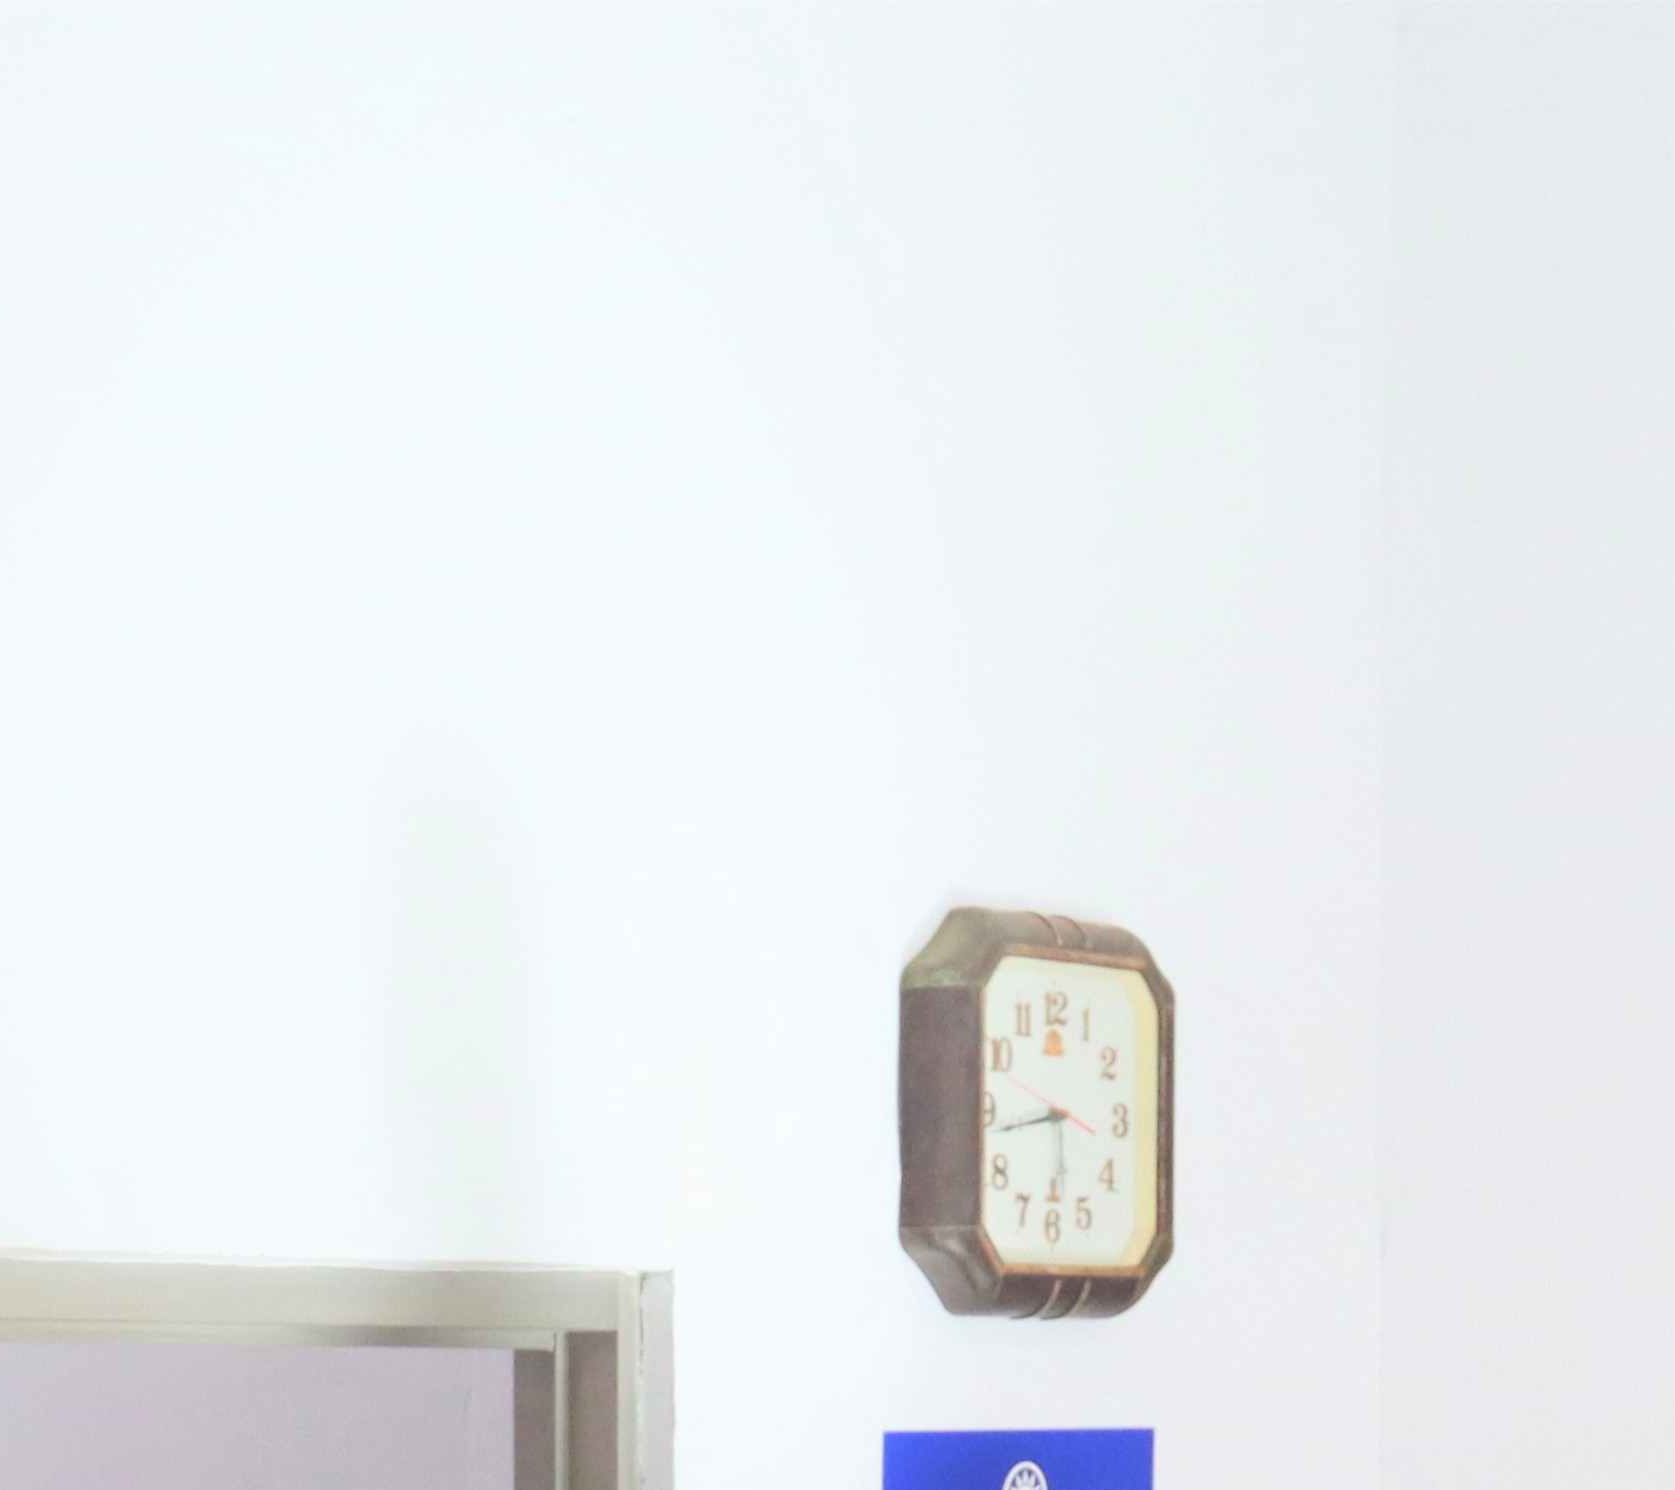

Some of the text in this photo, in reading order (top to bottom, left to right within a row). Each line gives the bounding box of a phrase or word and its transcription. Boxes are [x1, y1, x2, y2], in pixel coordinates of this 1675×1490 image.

[1014, 1002, 1032, 1039] 11
[1044, 990, 1069, 1027] 12
[1081, 1006, 1091, 1043] 1
[990, 1037, 1014, 1073] 10
[1100, 1046, 1118, 1081] 2
[1112, 1103, 1129, 1139] 3
[991, 1153, 1009, 1190] 8
[1098, 1158, 1117, 1192] 4
[1015, 1192, 1031, 1228] 7
[1044, 1208, 1061, 1244] 6
[1075, 1195, 1093, 1231] 5
